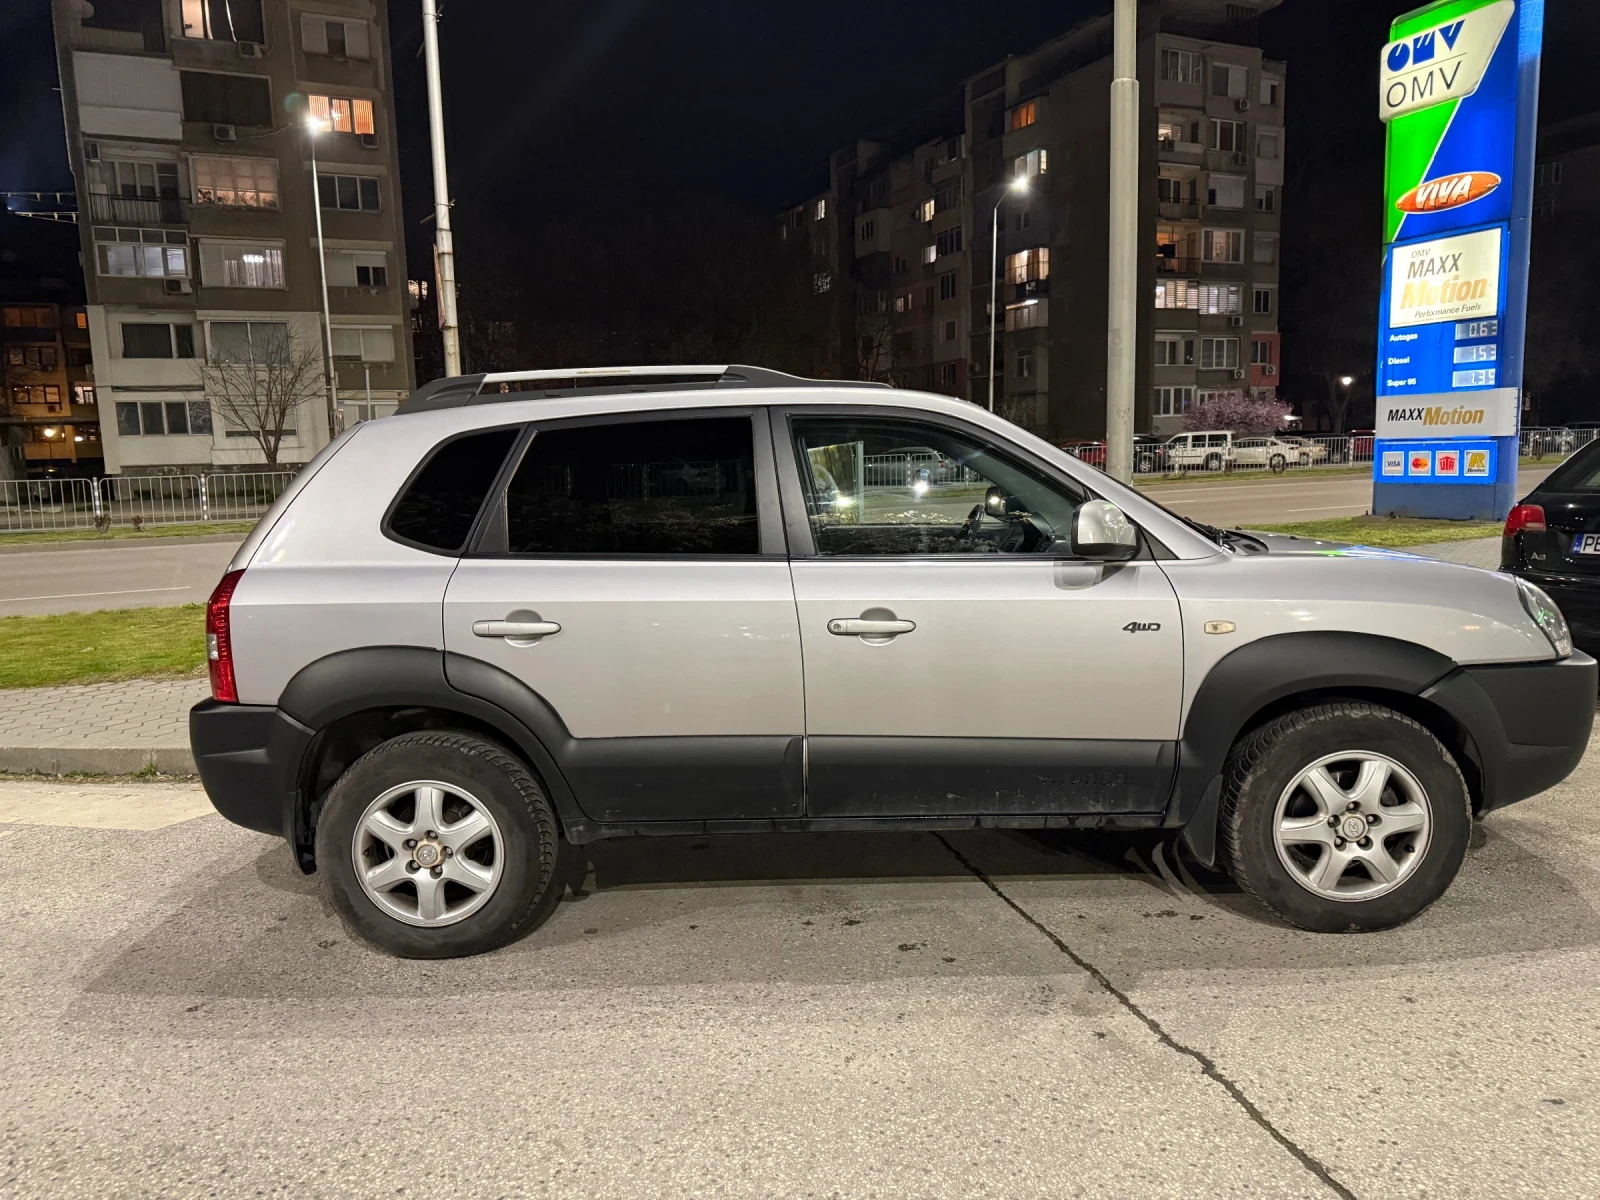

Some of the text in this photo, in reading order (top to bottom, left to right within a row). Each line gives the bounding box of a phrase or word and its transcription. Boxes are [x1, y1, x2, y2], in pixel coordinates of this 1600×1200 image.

[1386, 60, 1462, 108] OMV
[1416, 175, 1472, 209] VIVA
[1411, 248, 1431, 259] OMV
[1407, 252, 1462, 279] MAXX
[1400, 274, 1488, 309] Motion
[1415, 303, 1482, 318] Performance Fuels
[1389, 333, 1418, 342] Autogas
[1387, 356, 1410, 365] Diesel
[1387, 379, 1406, 387] Super
[1122, 621, 1161, 633] 4WD
